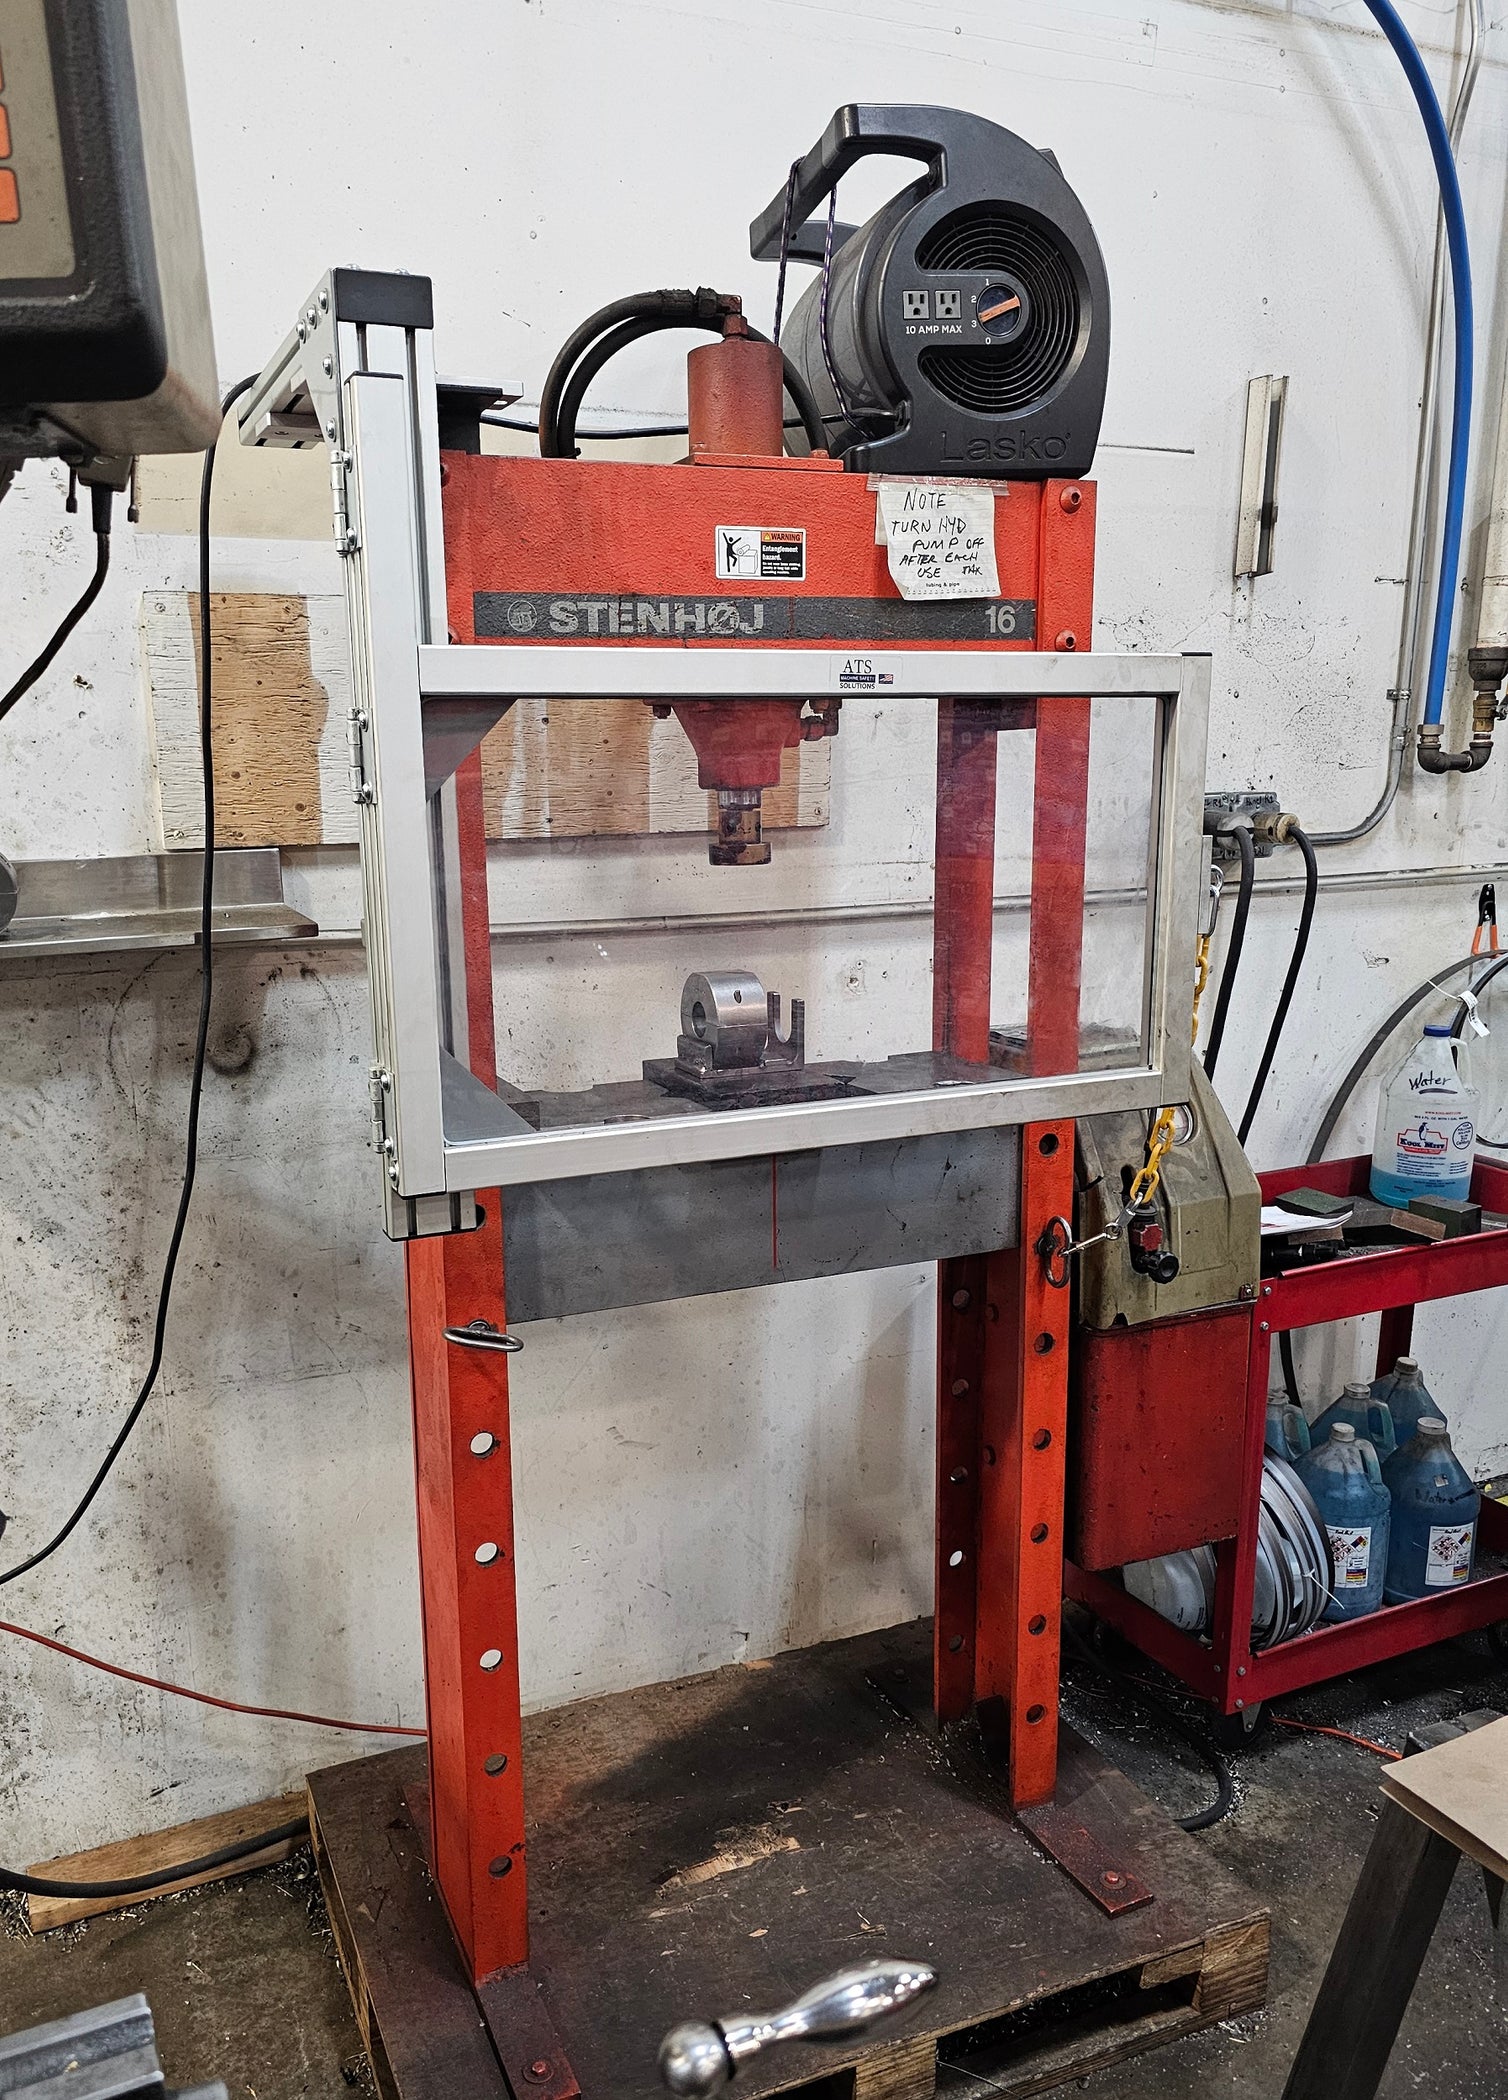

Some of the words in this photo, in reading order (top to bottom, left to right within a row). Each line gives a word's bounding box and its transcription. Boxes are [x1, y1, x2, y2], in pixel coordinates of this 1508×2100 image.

[985, 278, 990, 286] 1
[971, 295, 977, 303] 2
[906, 326, 916, 335] 10
[918, 325, 939, 334] AMP
[941, 325, 963, 334] MAX
[971, 320, 977, 328] 3
[985, 337, 991, 345] 0
[940, 430, 1067, 463] Lasko
[903, 488, 947, 511] NOTE
[892, 519, 931, 536] TURN
[938, 515, 967, 536] HYD
[770, 532, 801, 541] WARNING
[762, 545, 799, 553] Entanglement
[912, 537, 959, 553] PUMP
[966, 537, 985, 550] OFF
[899, 554, 938, 566] AFTER
[944, 552, 979, 563] EACH
[917, 567, 942, 579] USE
[550, 600, 764, 634] STENHØJ
[985, 605, 1016, 634] 16
[842, 659, 872, 674] ATS
[839, 682, 876, 690] SOLUTIONS
[1408, 1070, 1452, 1091] Water
